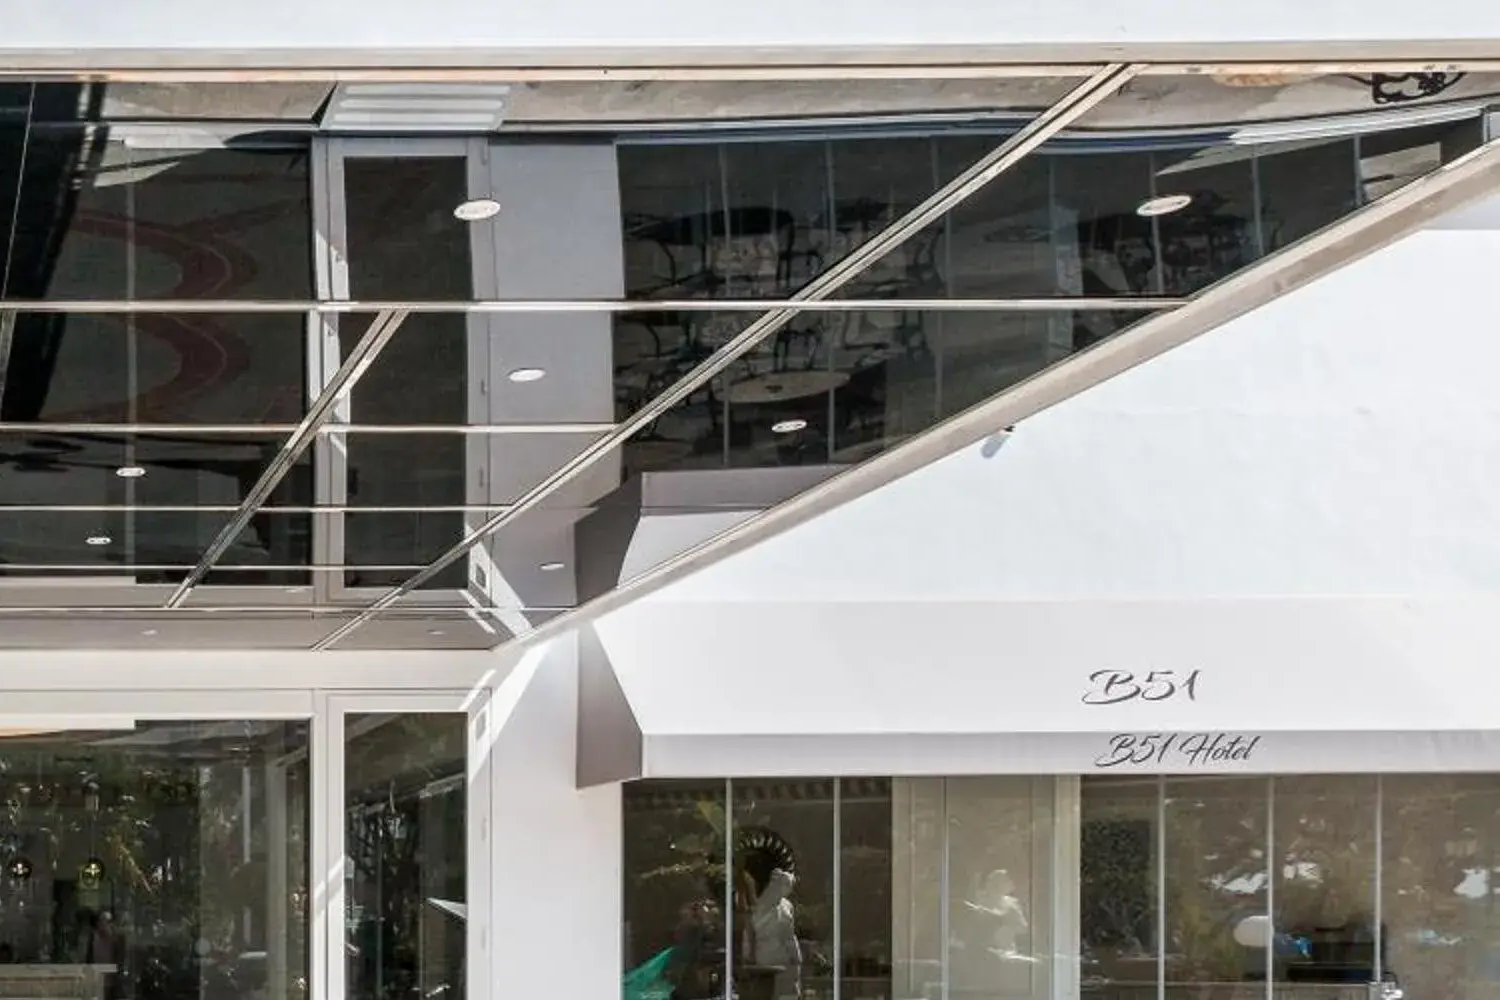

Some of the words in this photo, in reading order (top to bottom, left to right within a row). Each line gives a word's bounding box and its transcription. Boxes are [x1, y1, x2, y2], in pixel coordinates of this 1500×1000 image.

[1082, 669, 1201, 705] B51
[1095, 733, 1178, 767] B51
[1179, 733, 1261, 765] Hotel
